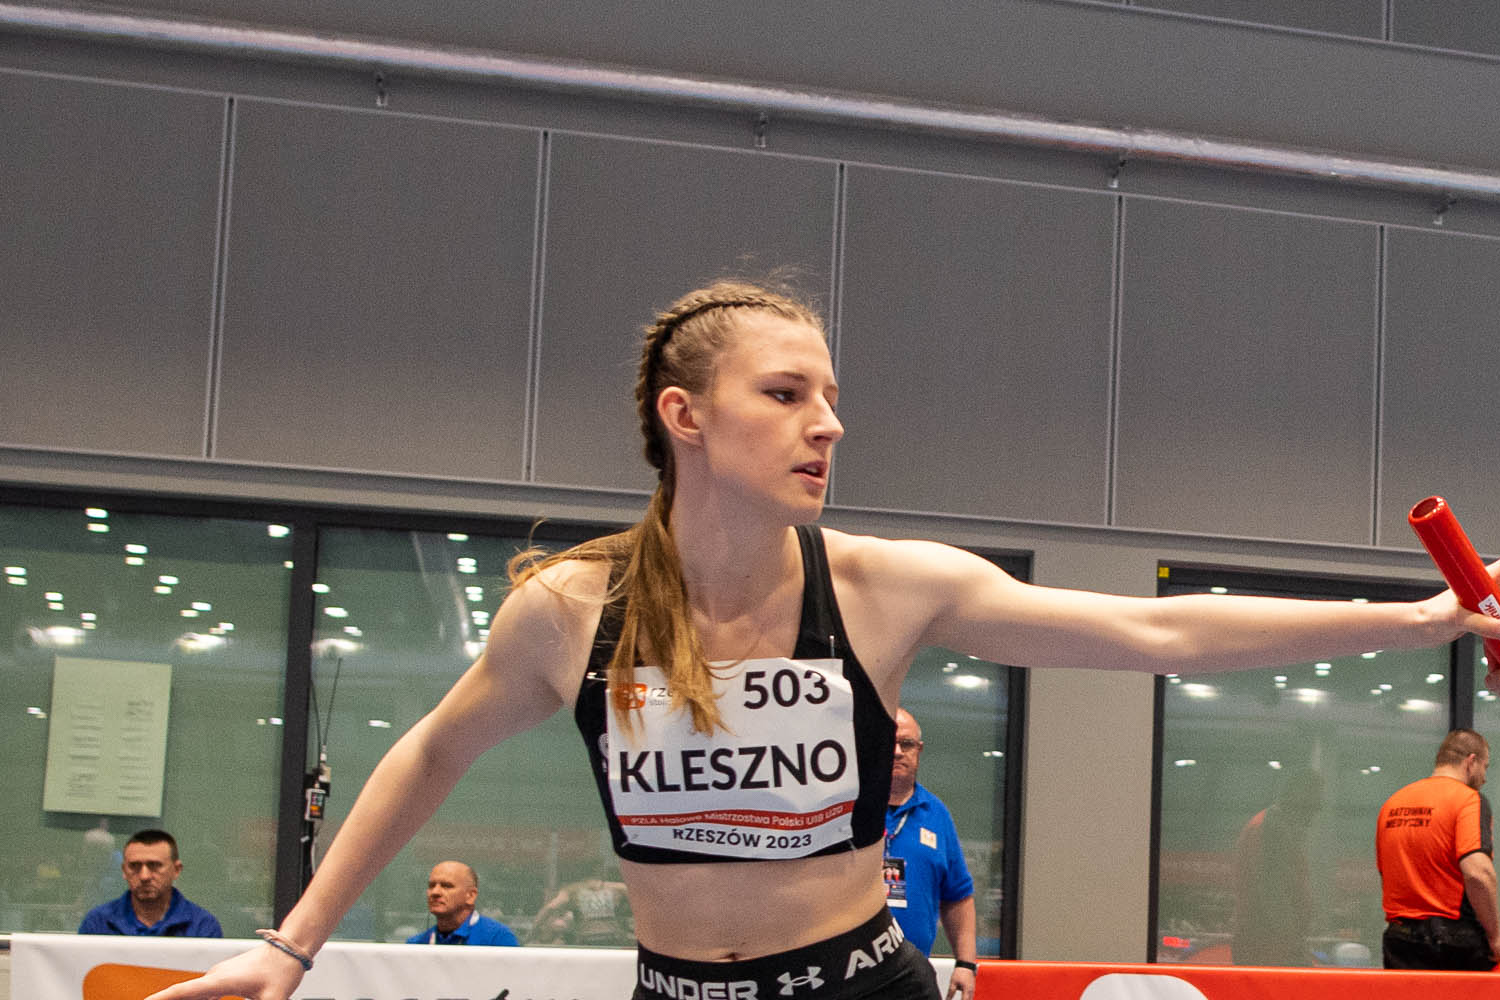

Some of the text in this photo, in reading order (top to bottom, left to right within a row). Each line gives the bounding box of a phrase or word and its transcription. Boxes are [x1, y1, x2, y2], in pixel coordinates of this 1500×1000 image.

[743, 668, 830, 710] 503
[619, 739, 847, 793] KLESZNO
[672, 826, 813, 849] RZESZÓW 2023
[704, 812, 770, 825] Mistrzostwa
[772, 815, 804, 827] Polski
[844, 917, 905, 980] ARM
